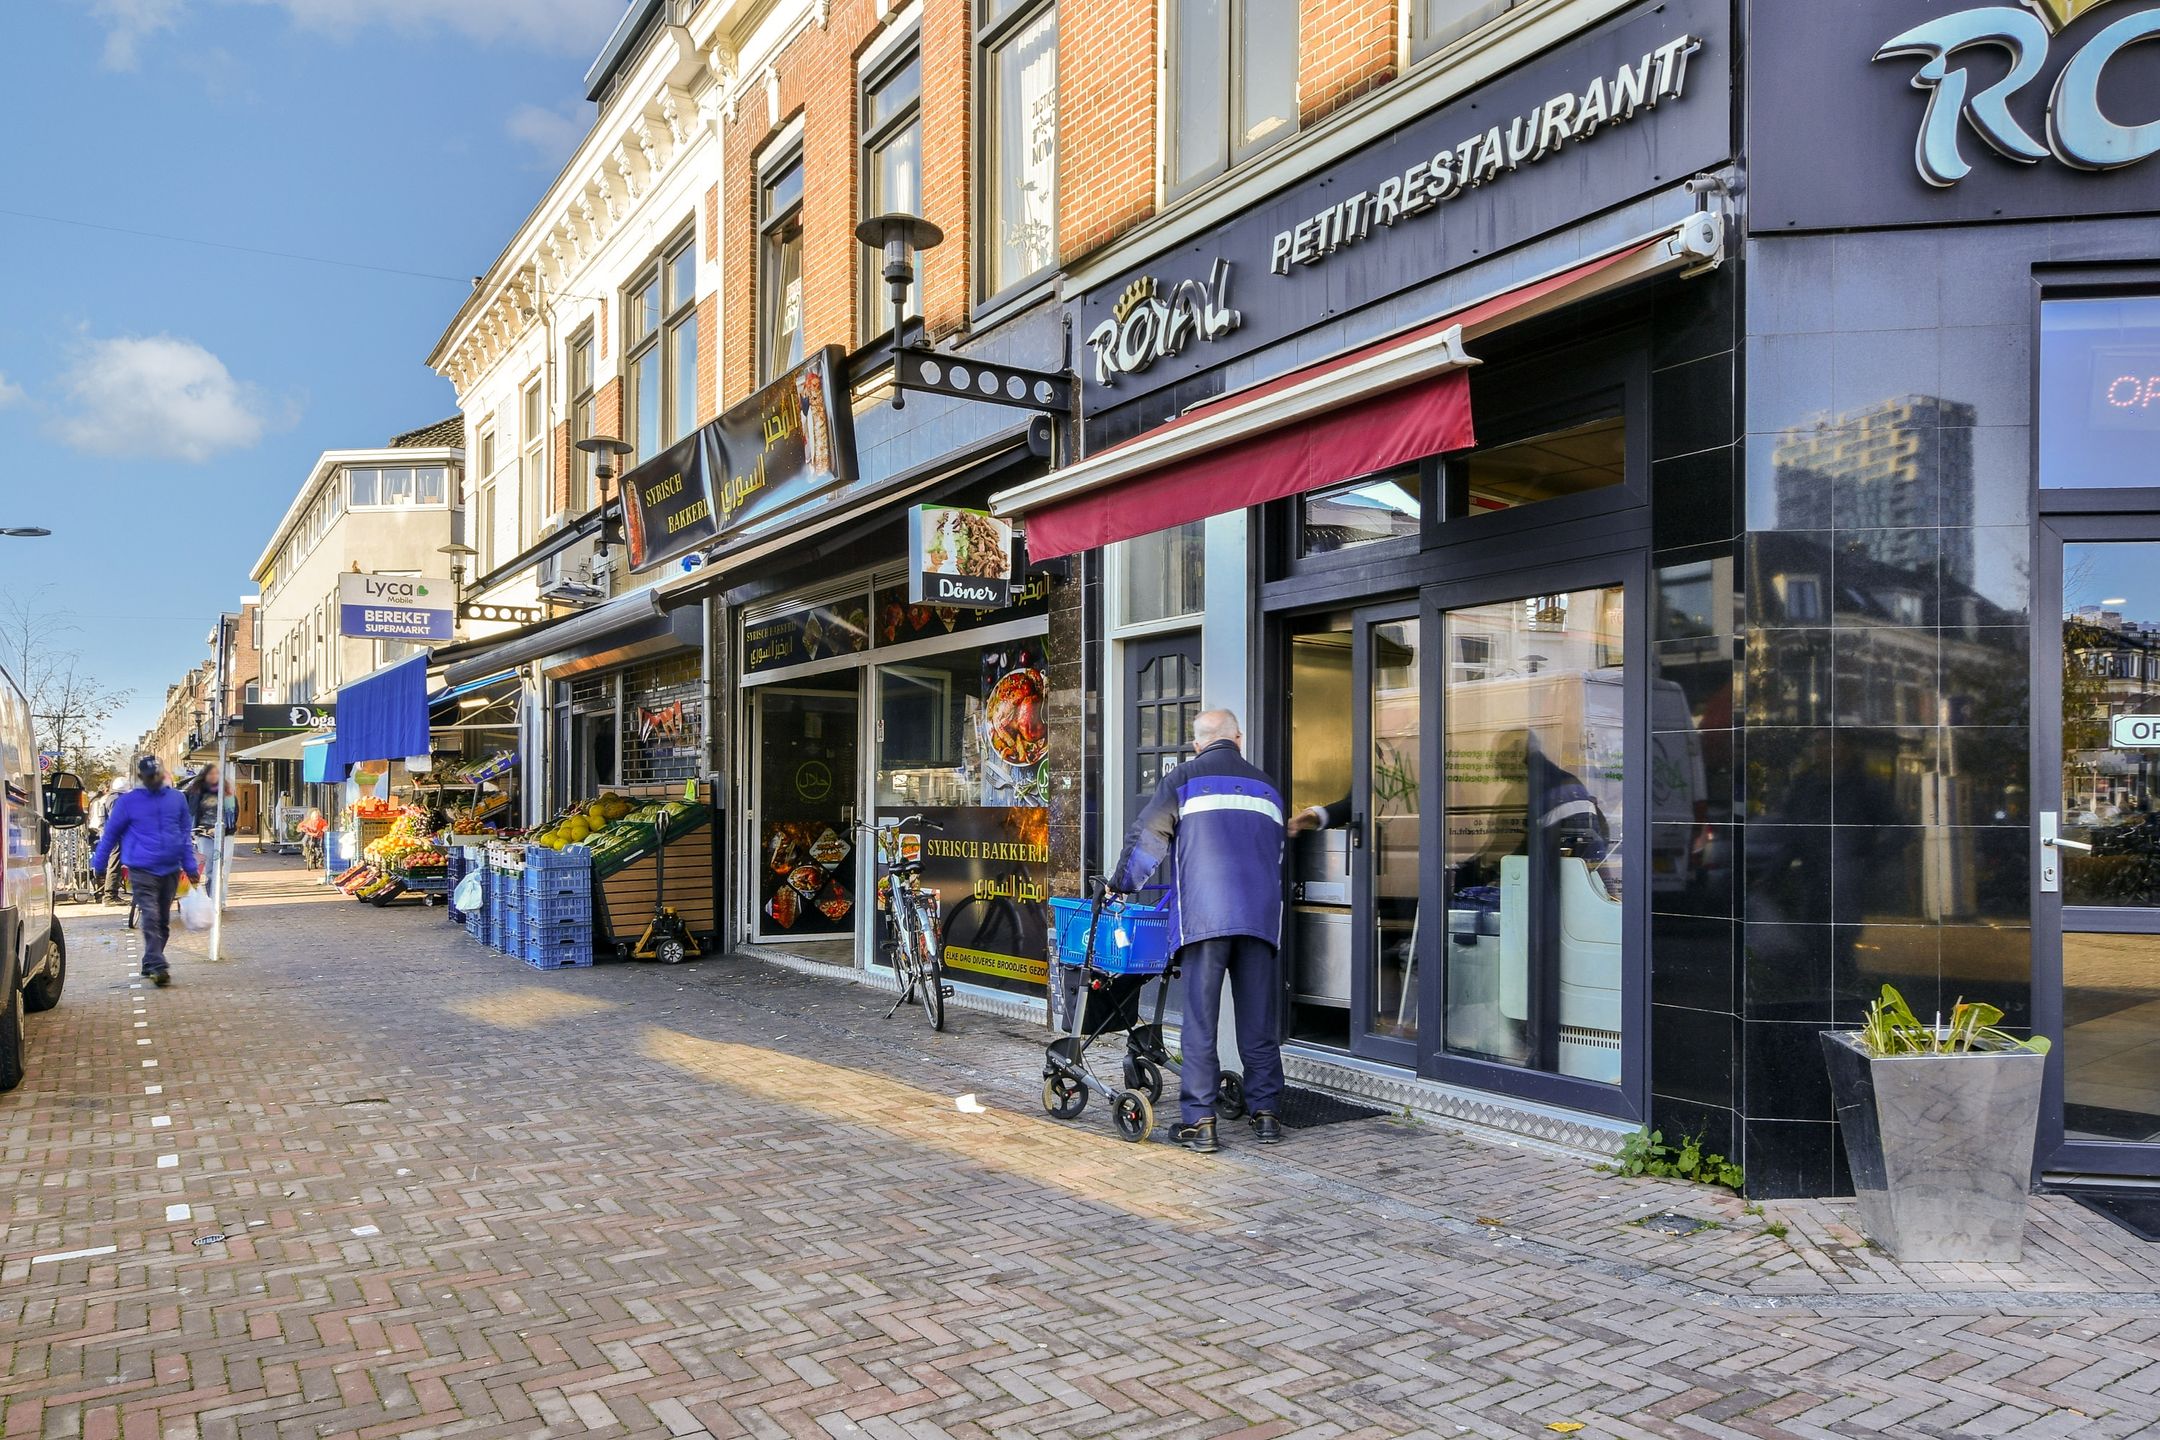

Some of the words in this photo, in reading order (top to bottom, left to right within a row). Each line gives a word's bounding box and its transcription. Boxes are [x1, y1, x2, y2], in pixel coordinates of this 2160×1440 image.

[1271, 191, 1379, 275] PETIT
[1375, 34, 1702, 227] RESTAURANT
[1086, 257, 1241, 388] ROYAL
[645, 472, 683, 508] SYRISCH
[667, 498, 710, 534] BAKKERI
[366, 579, 413, 597] Lyca
[939, 578, 997, 601] Döner
[387, 596, 414, 604] Mobile
[364, 609, 431, 625] BEREKET
[365, 623, 431, 635] SUPERMARKT
[927, 839, 979, 859] SYRISCH
[982, 842, 1048, 863] BAKKERIJ
[946, 951, 959, 961] ELKE
[960, 953, 972, 964] DAG
[973, 956, 996, 968] DIVERSE
[997, 960, 1028, 974] BROODJES
